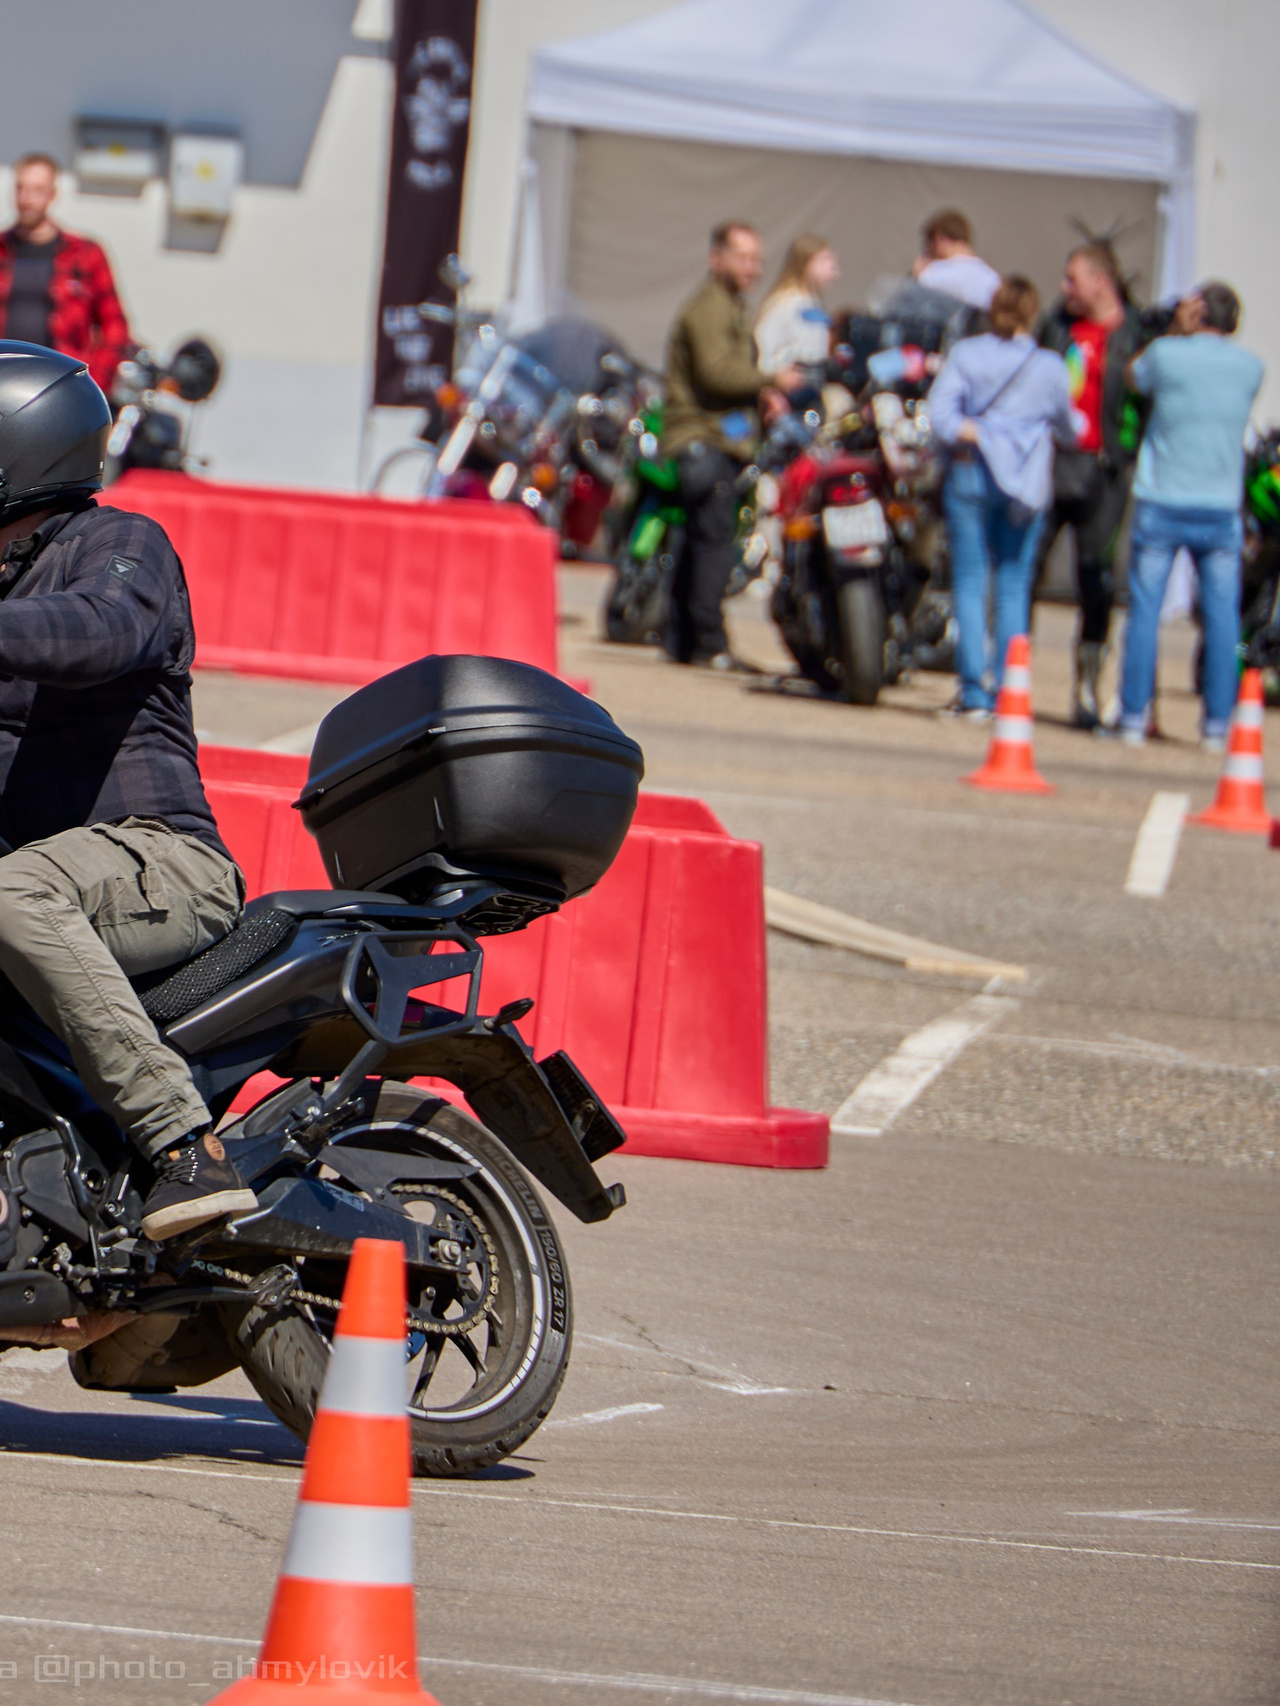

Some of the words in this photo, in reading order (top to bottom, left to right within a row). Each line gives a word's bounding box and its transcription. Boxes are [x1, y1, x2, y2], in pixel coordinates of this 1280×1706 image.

[483, 1142, 543, 1220] MICHELIN
[542, 1230, 563, 1284] 150/60
[552, 1287, 565, 1310] ZR
[552, 1312, 565, 1329] 17
